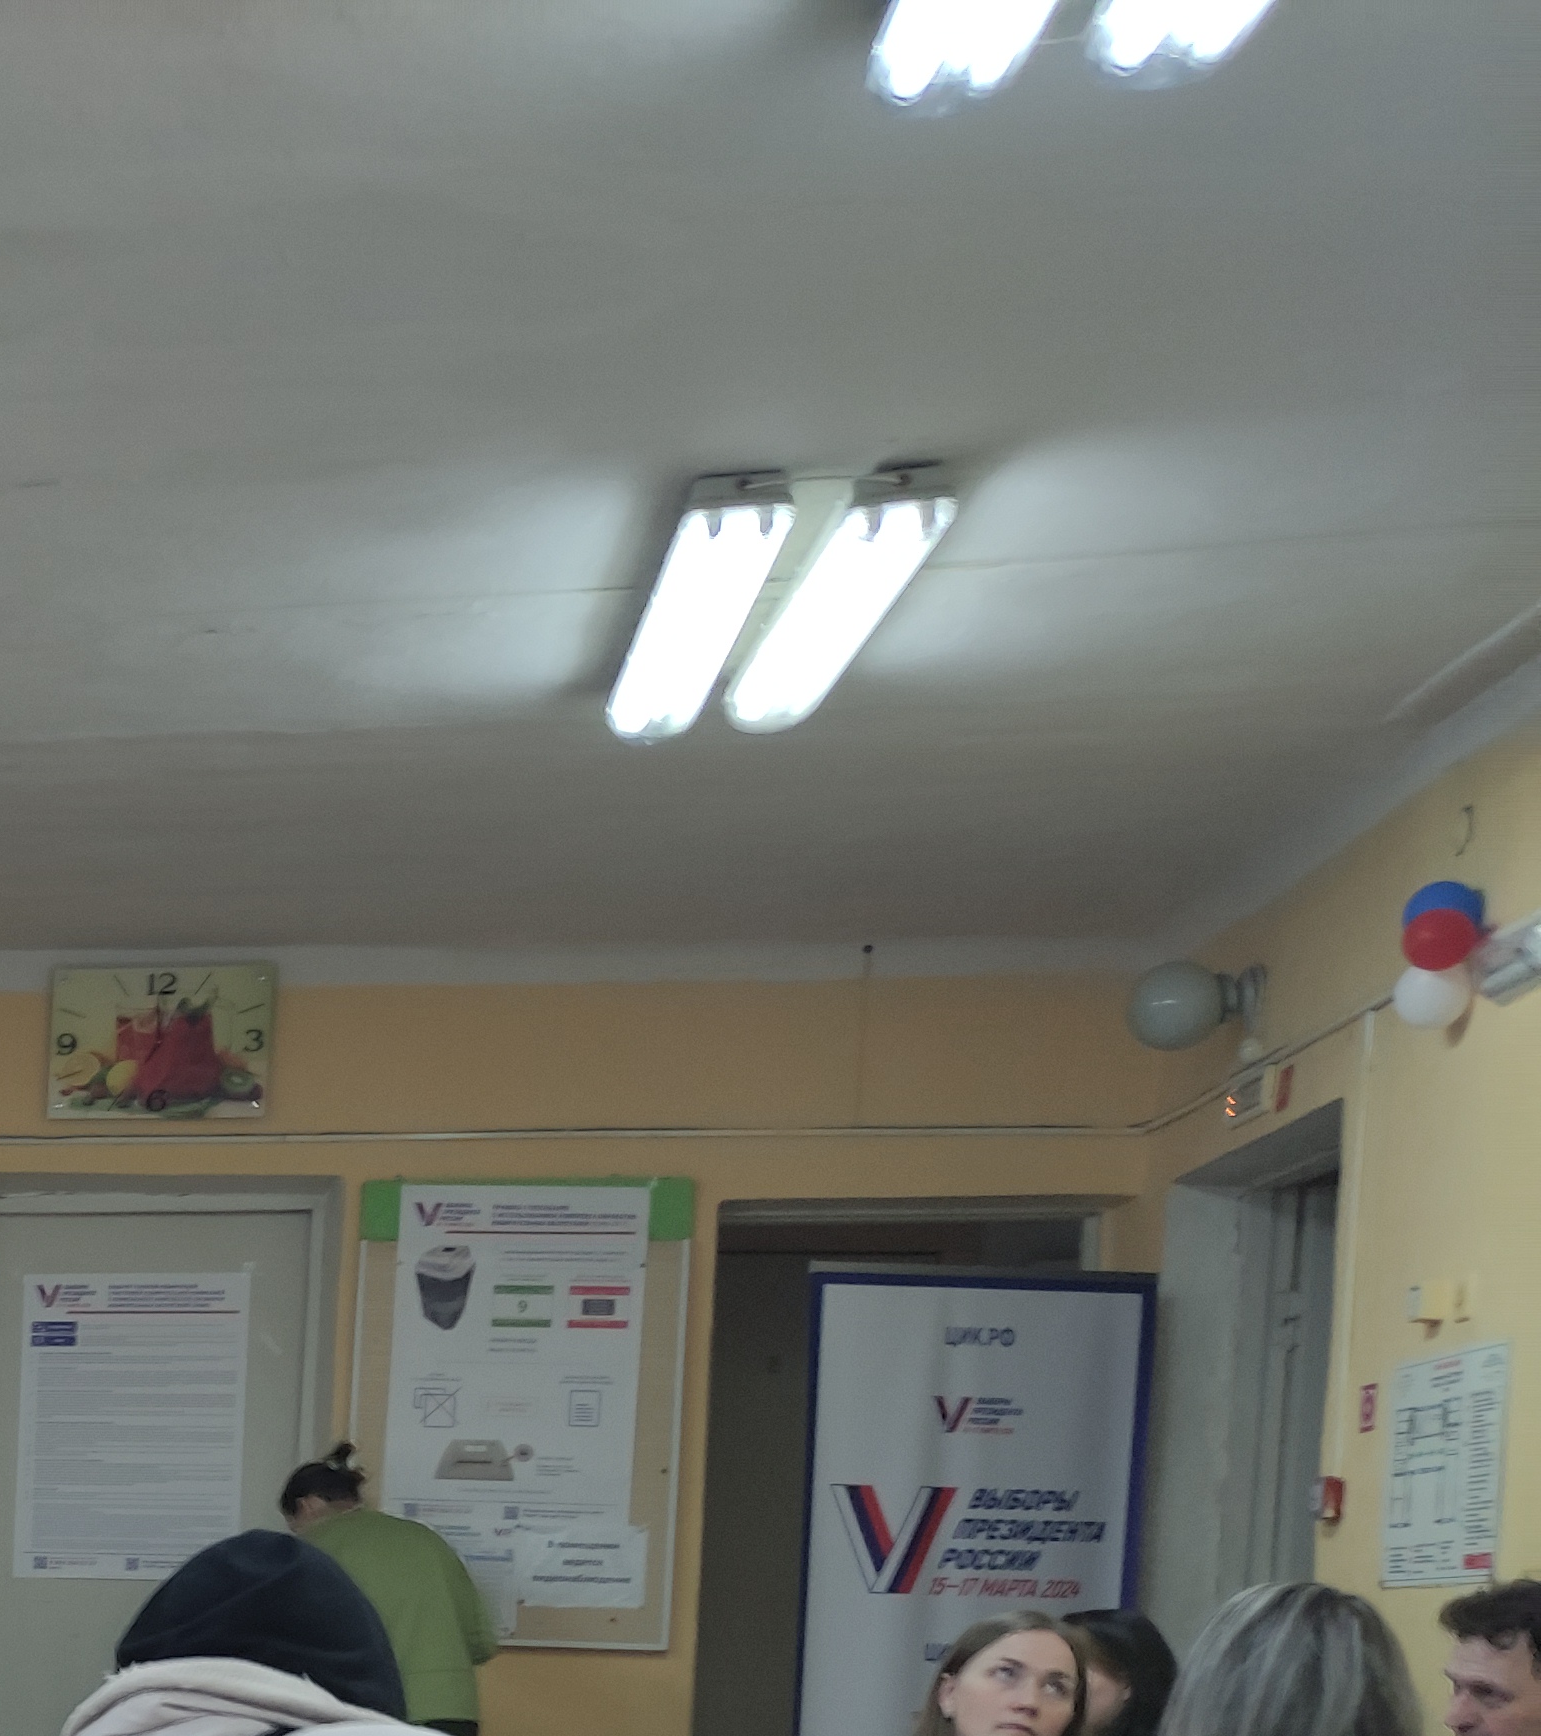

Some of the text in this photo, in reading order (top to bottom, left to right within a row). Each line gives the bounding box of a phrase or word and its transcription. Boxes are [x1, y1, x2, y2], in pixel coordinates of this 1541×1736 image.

[147, 973, 177, 996] 12
[56, 1033, 77, 1055] 9
[244, 1029, 264, 1052] 3
[944, 1326, 1016, 1347] ЦИК.РФ
[968, 1488, 1079, 1512] ВЫБОРЫ
[953, 1519, 1107, 1545] ПРЕЗИДЕНТА
[937, 1549, 1043, 1572] РОССИИ
[979, 1578, 1038, 1597] МАРТА
[1040, 1579, 1083, 1599] 2024
